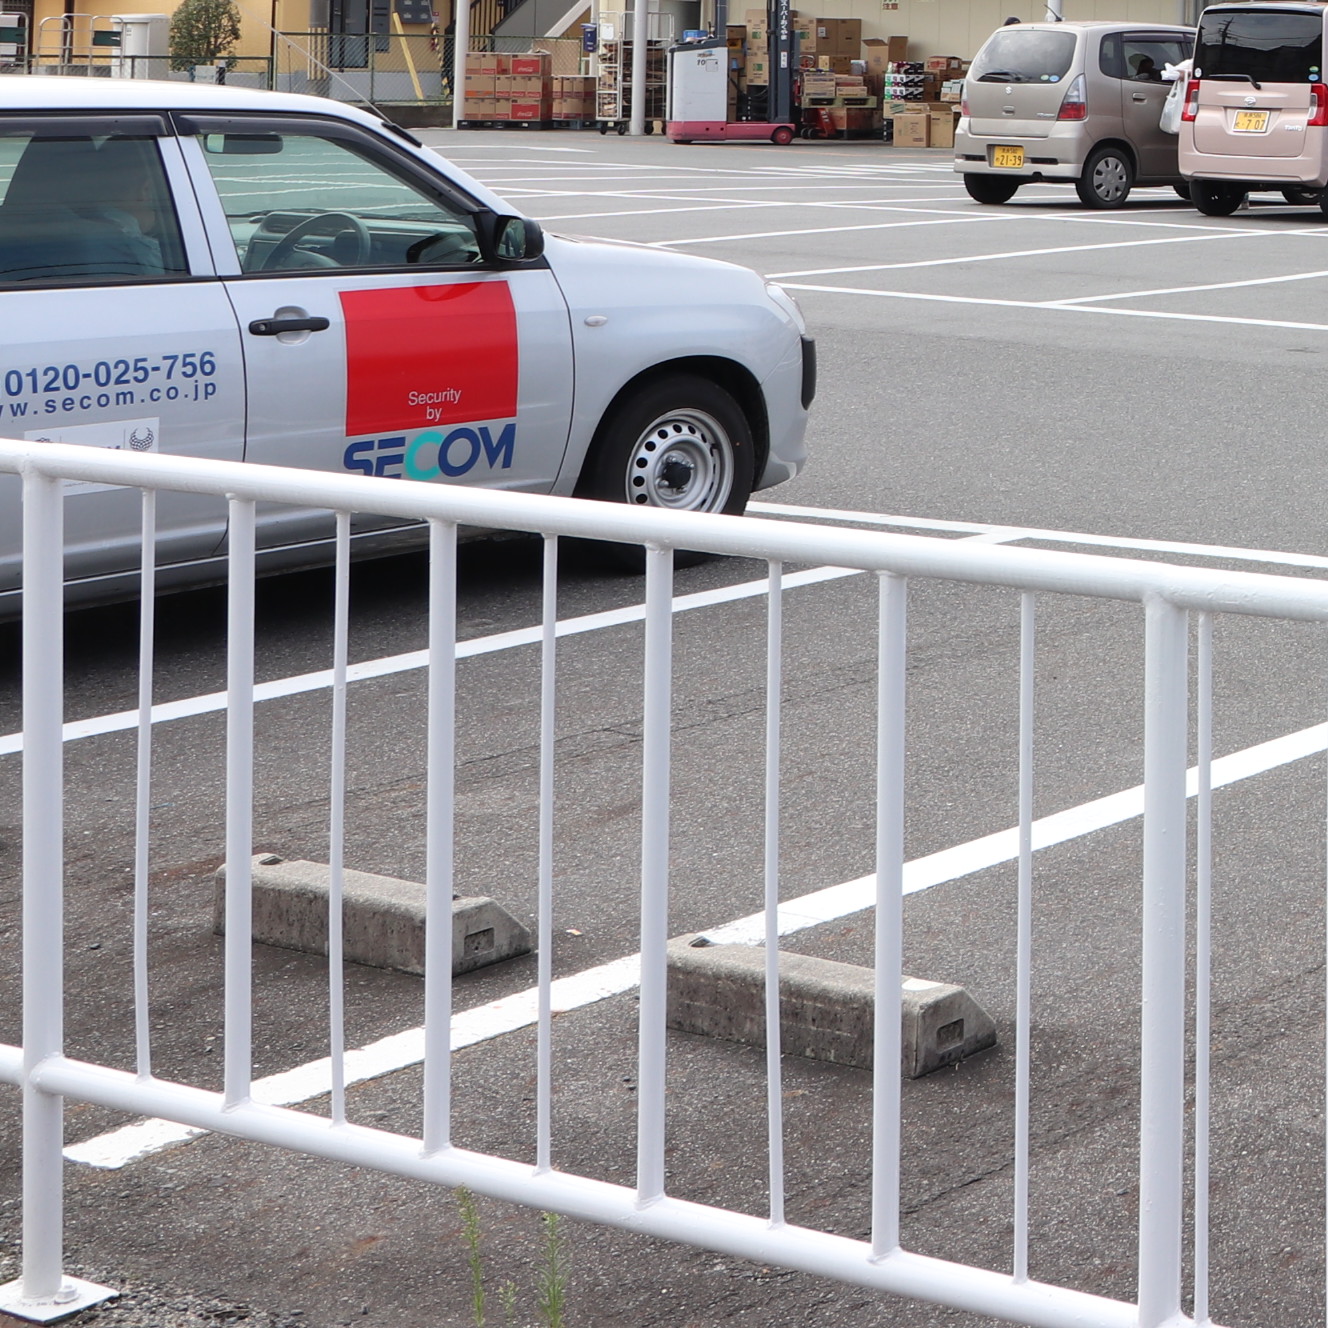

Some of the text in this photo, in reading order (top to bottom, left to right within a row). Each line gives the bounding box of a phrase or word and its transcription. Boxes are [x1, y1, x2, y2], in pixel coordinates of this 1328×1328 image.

[1000, 155, 1022, 166] 21-39
[5, 351, 216, 397] 0120-025-756
[0, 380, 217, 420] w.secom.co.jp
[408, 388, 462, 406] Security
[426, 406, 443, 422] by
[343, 423, 517, 482] SECOM
